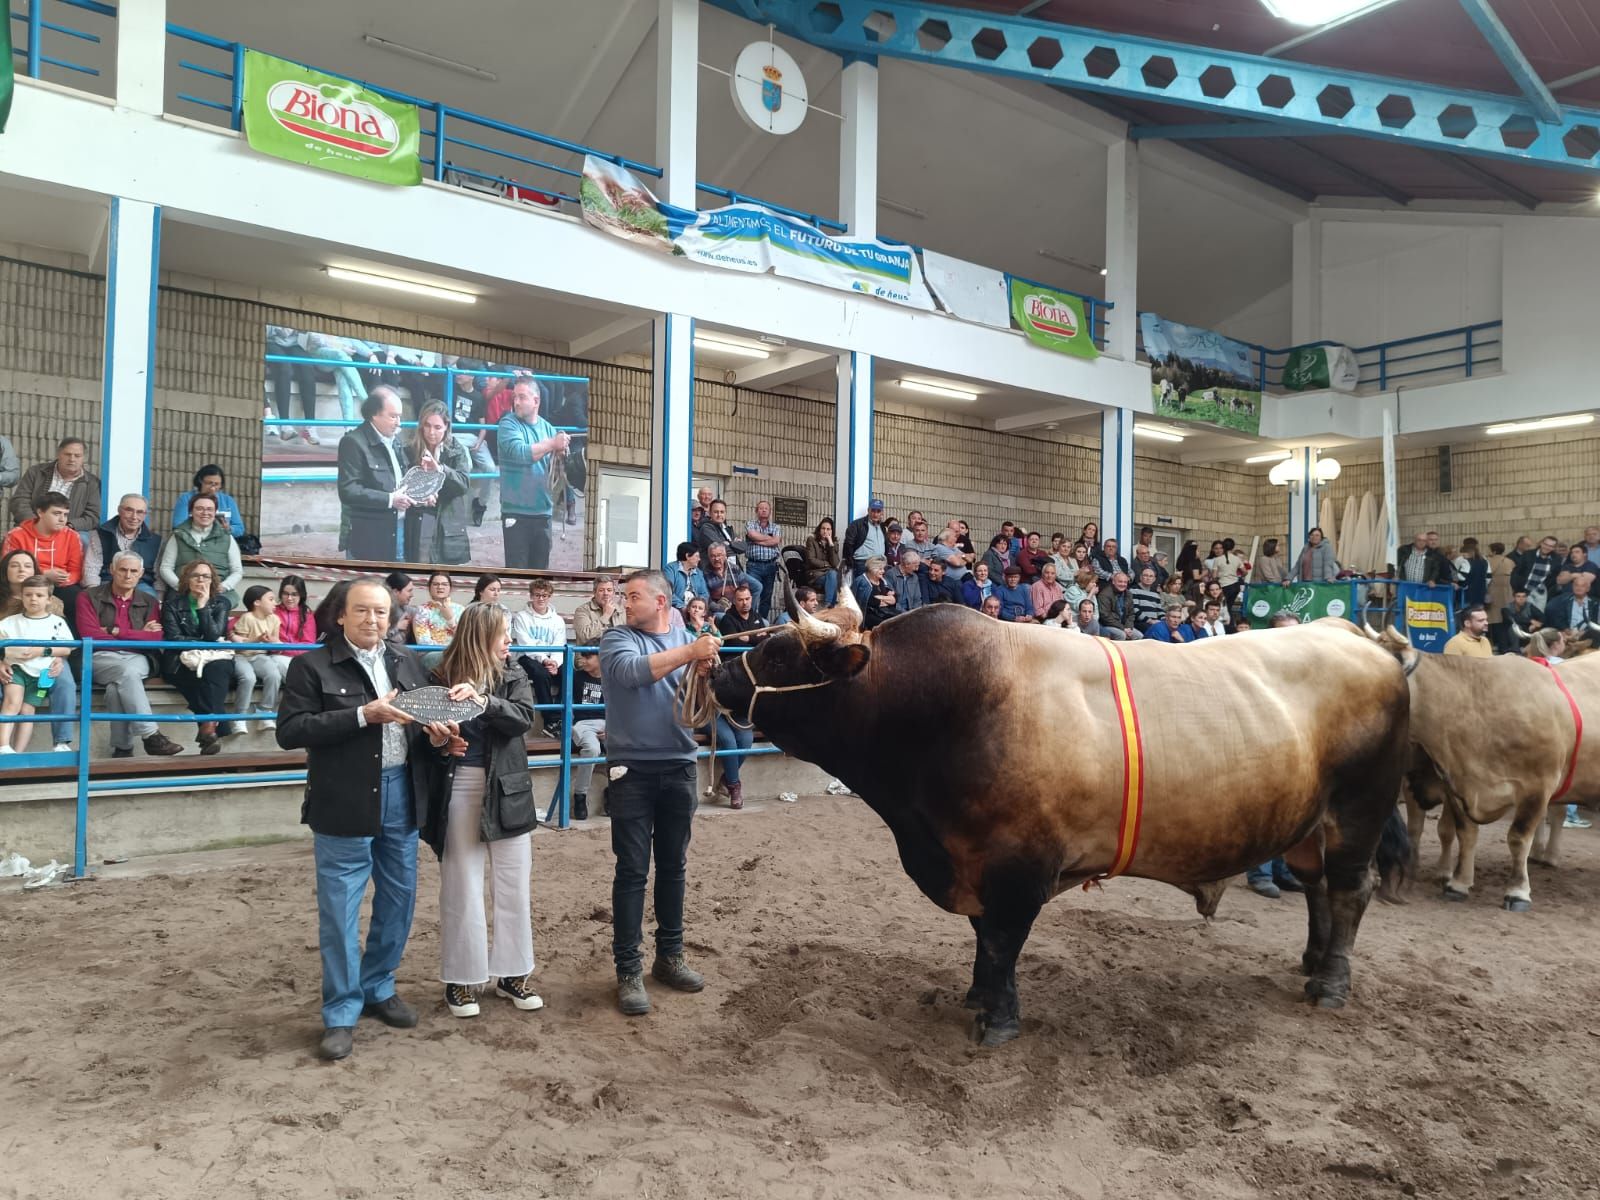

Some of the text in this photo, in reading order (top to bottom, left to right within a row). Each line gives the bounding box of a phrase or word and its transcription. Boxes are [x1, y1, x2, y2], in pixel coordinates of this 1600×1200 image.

[283, 88, 385, 139] Biona
[774, 224, 787, 239] EL
[874, 252, 910, 270] GRANJA
[876, 287, 909, 301] de heus
[1032, 299, 1072, 327] Biona
